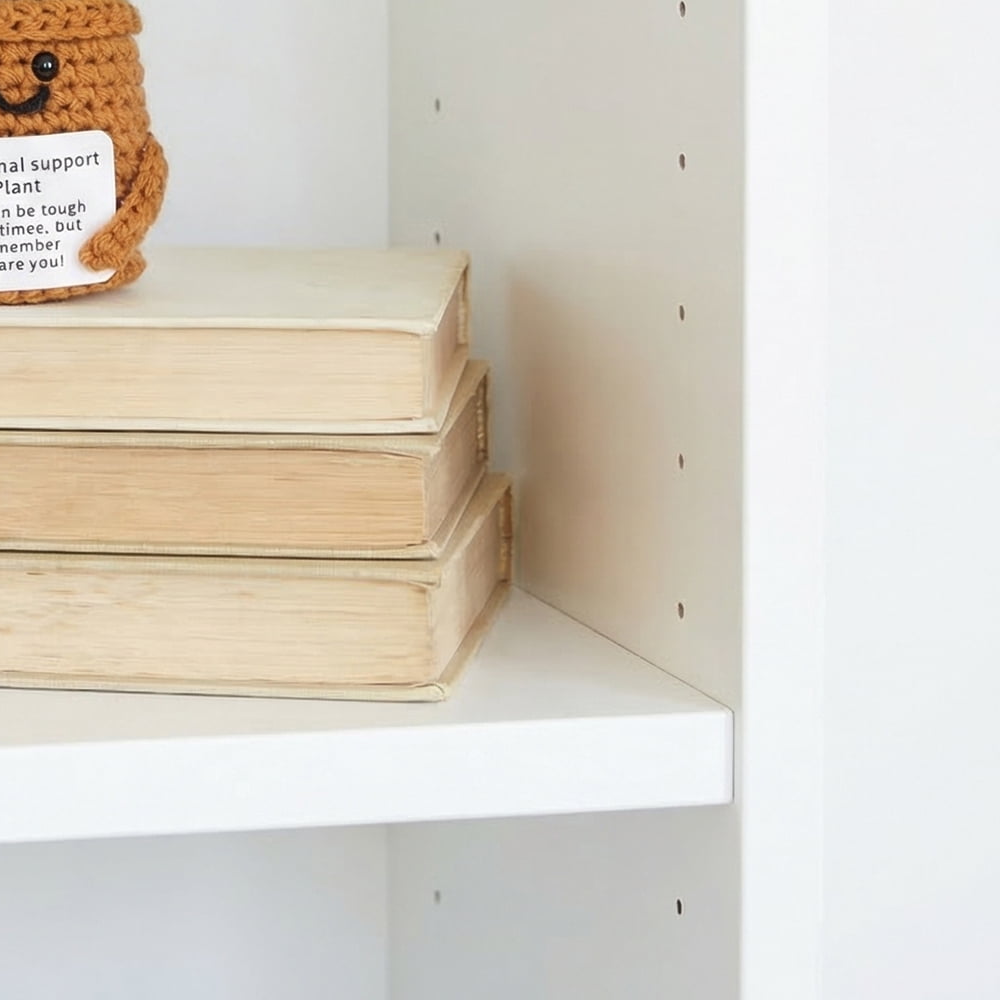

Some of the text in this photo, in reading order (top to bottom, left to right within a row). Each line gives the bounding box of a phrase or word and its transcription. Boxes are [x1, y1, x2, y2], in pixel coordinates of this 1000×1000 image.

[30, 152, 100, 173] support
[16, 204, 36, 218] be
[42, 199, 86, 217] tough
[55, 220, 83, 232] but
[29, 255, 64, 273] you!
